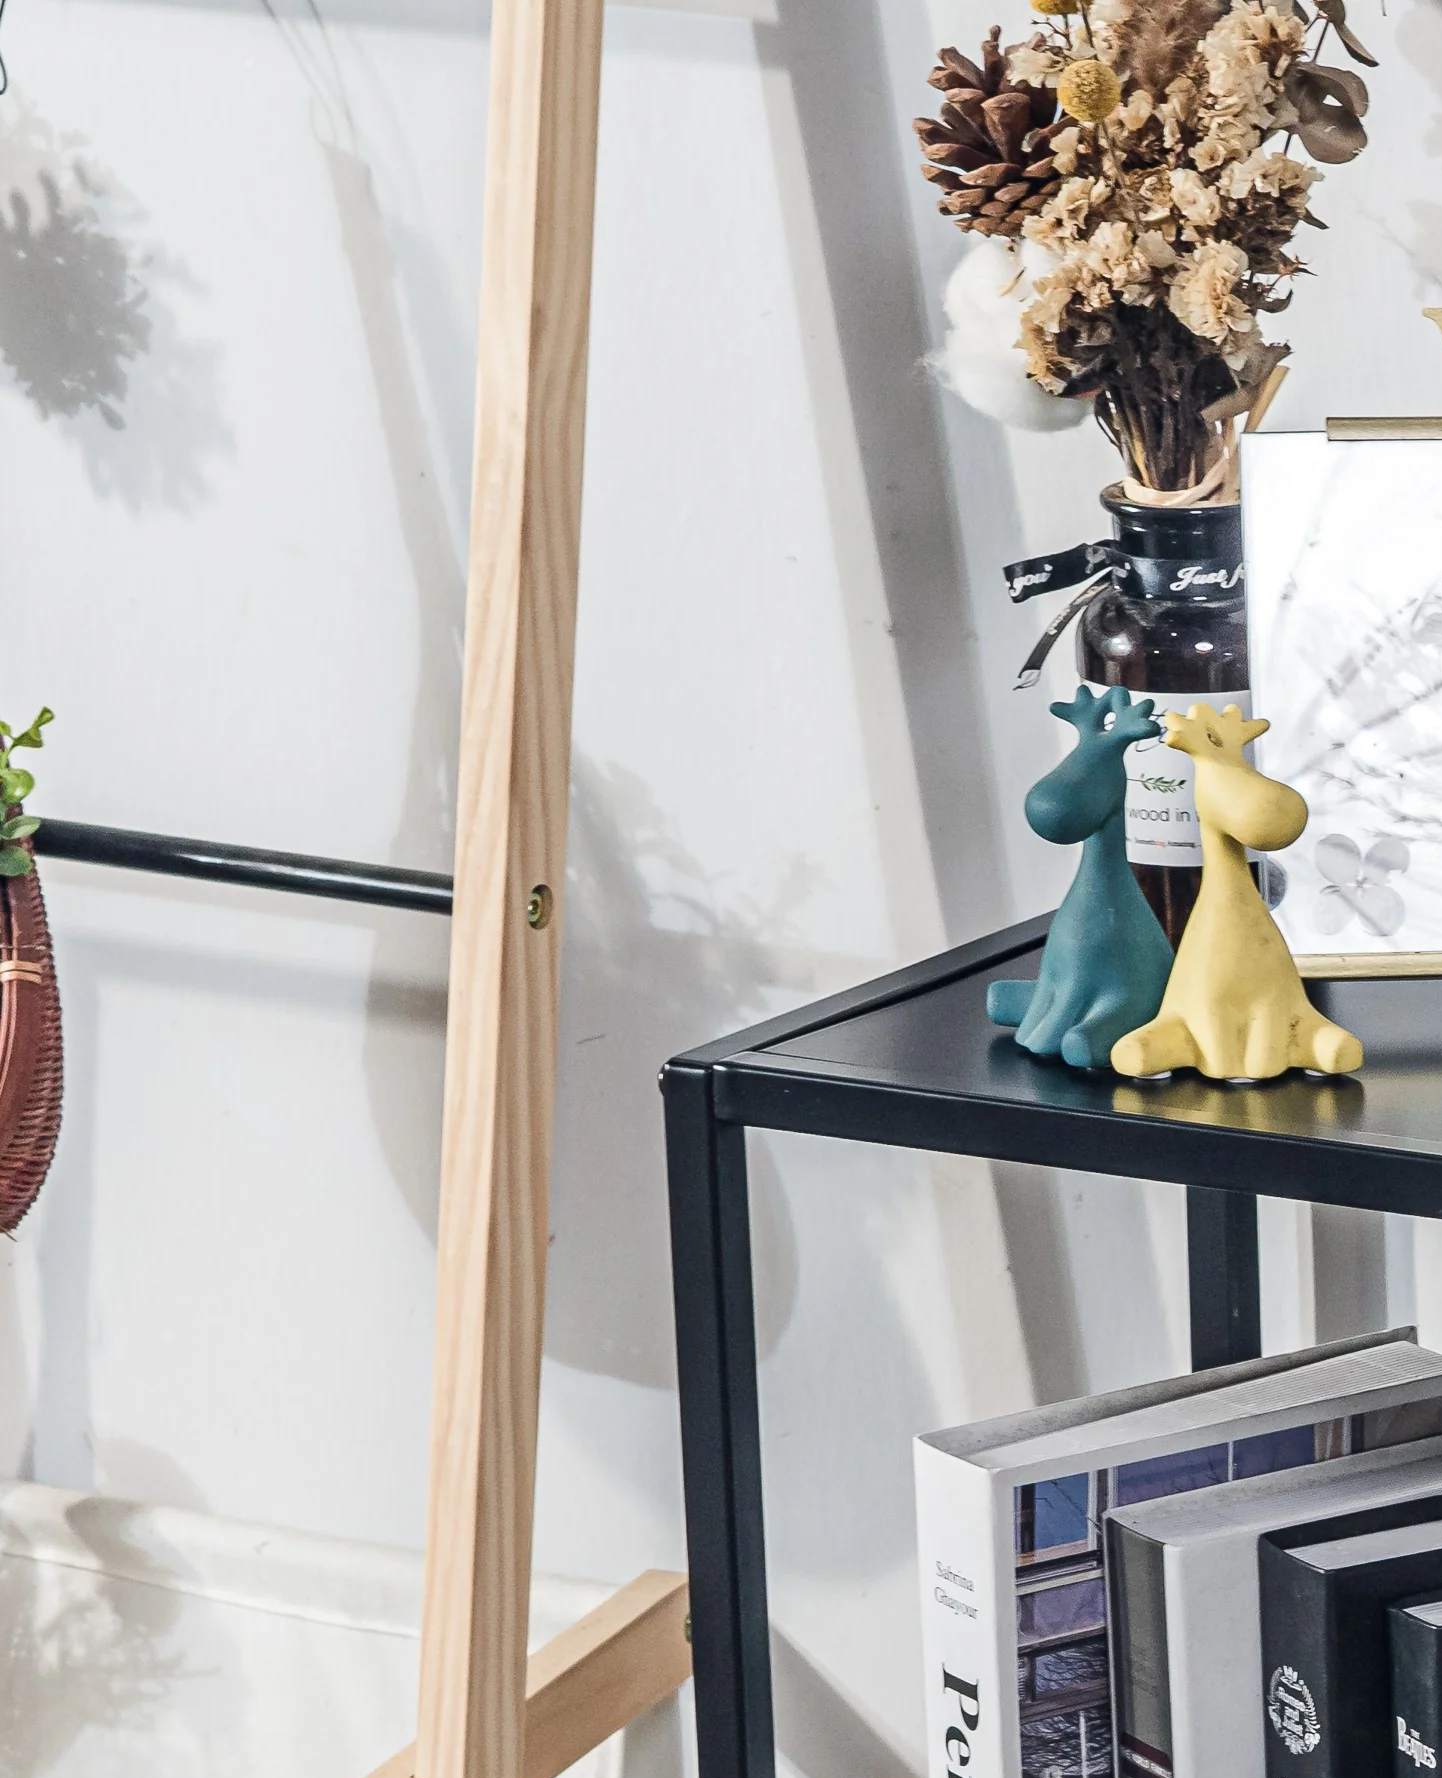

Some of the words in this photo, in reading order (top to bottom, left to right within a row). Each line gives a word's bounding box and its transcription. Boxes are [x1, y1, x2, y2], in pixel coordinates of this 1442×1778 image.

[1169, 565, 1229, 591] Just
[1174, 807, 1191, 823] in
[936, 1560, 975, 1592] Sabrina
[933, 1585, 979, 1620] Ghayour
